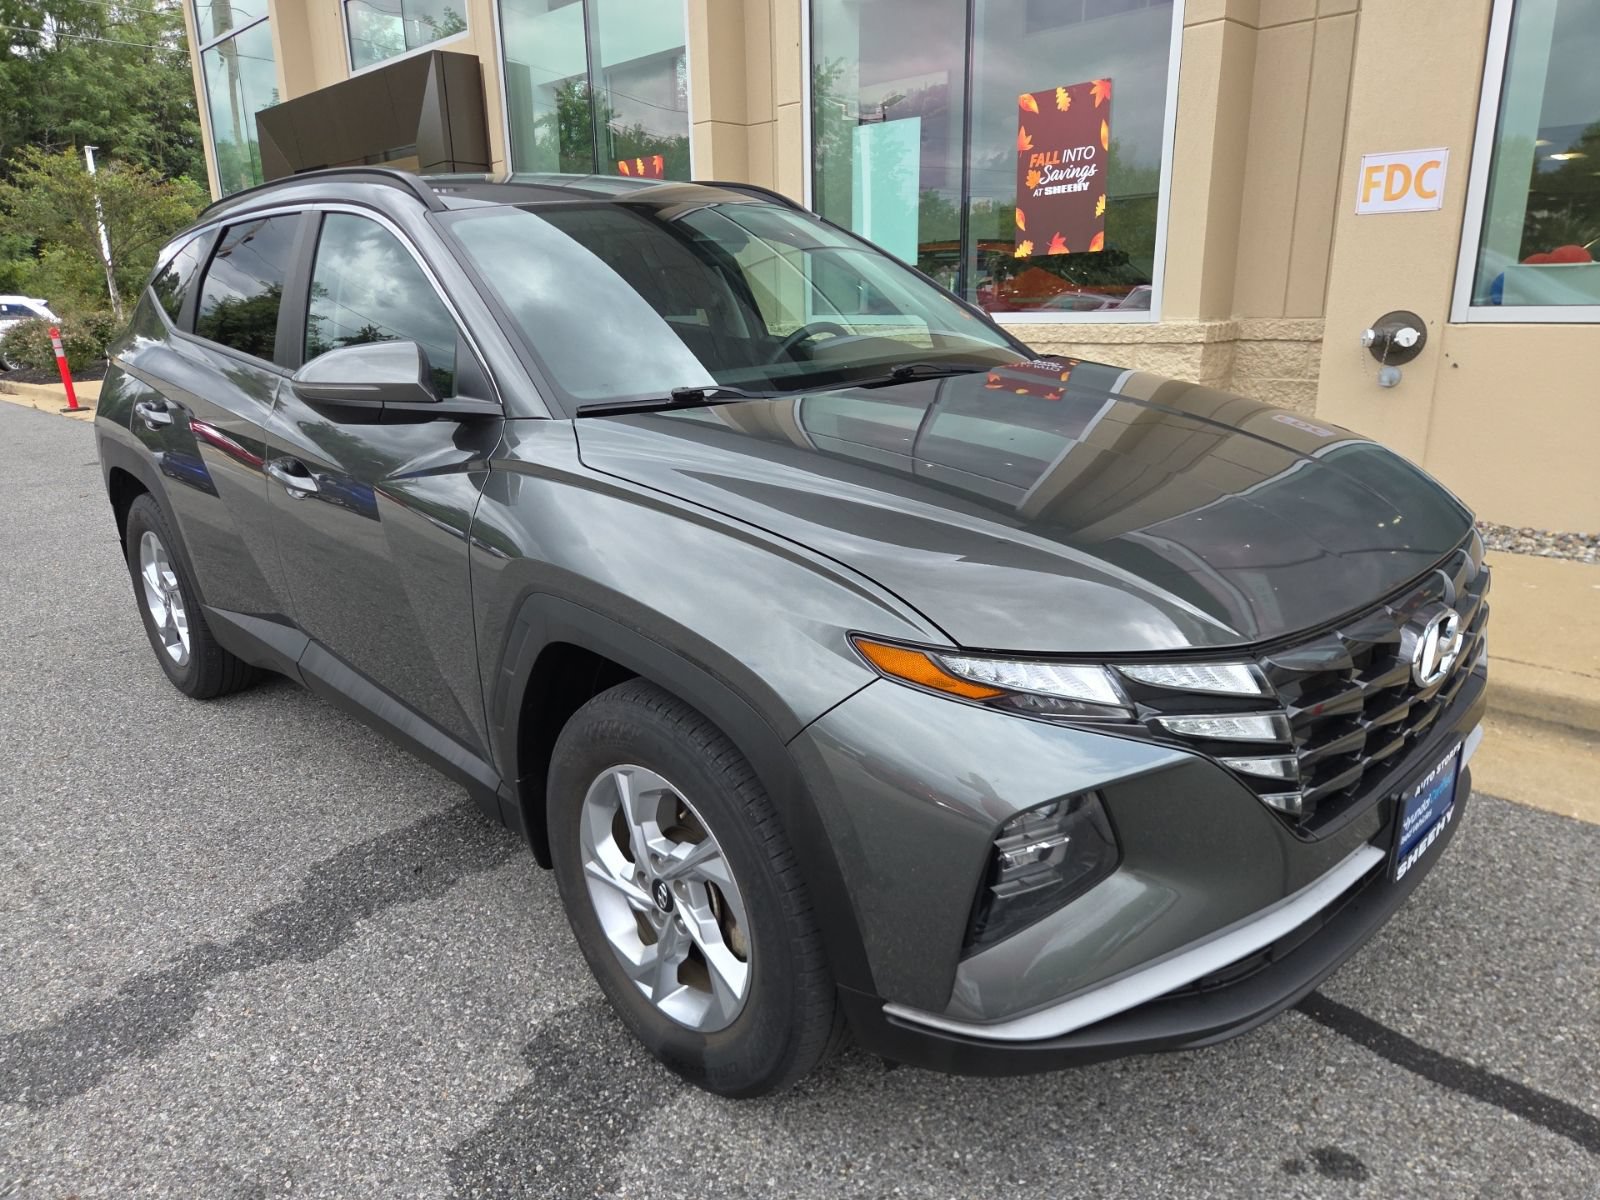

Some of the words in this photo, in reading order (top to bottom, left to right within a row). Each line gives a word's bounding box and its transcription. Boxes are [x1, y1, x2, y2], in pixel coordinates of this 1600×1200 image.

[1029, 151, 1060, 168] FALL
[1062, 146, 1096, 163] INTO
[1039, 164, 1099, 184] Savings
[1361, 160, 1441, 203] FDC
[1033, 189, 1044, 197] AT
[1044, 182, 1090, 196] SHEEHY
[1414, 770, 1436, 798] AUTO
[1396, 803, 1455, 881] SHEEHY
